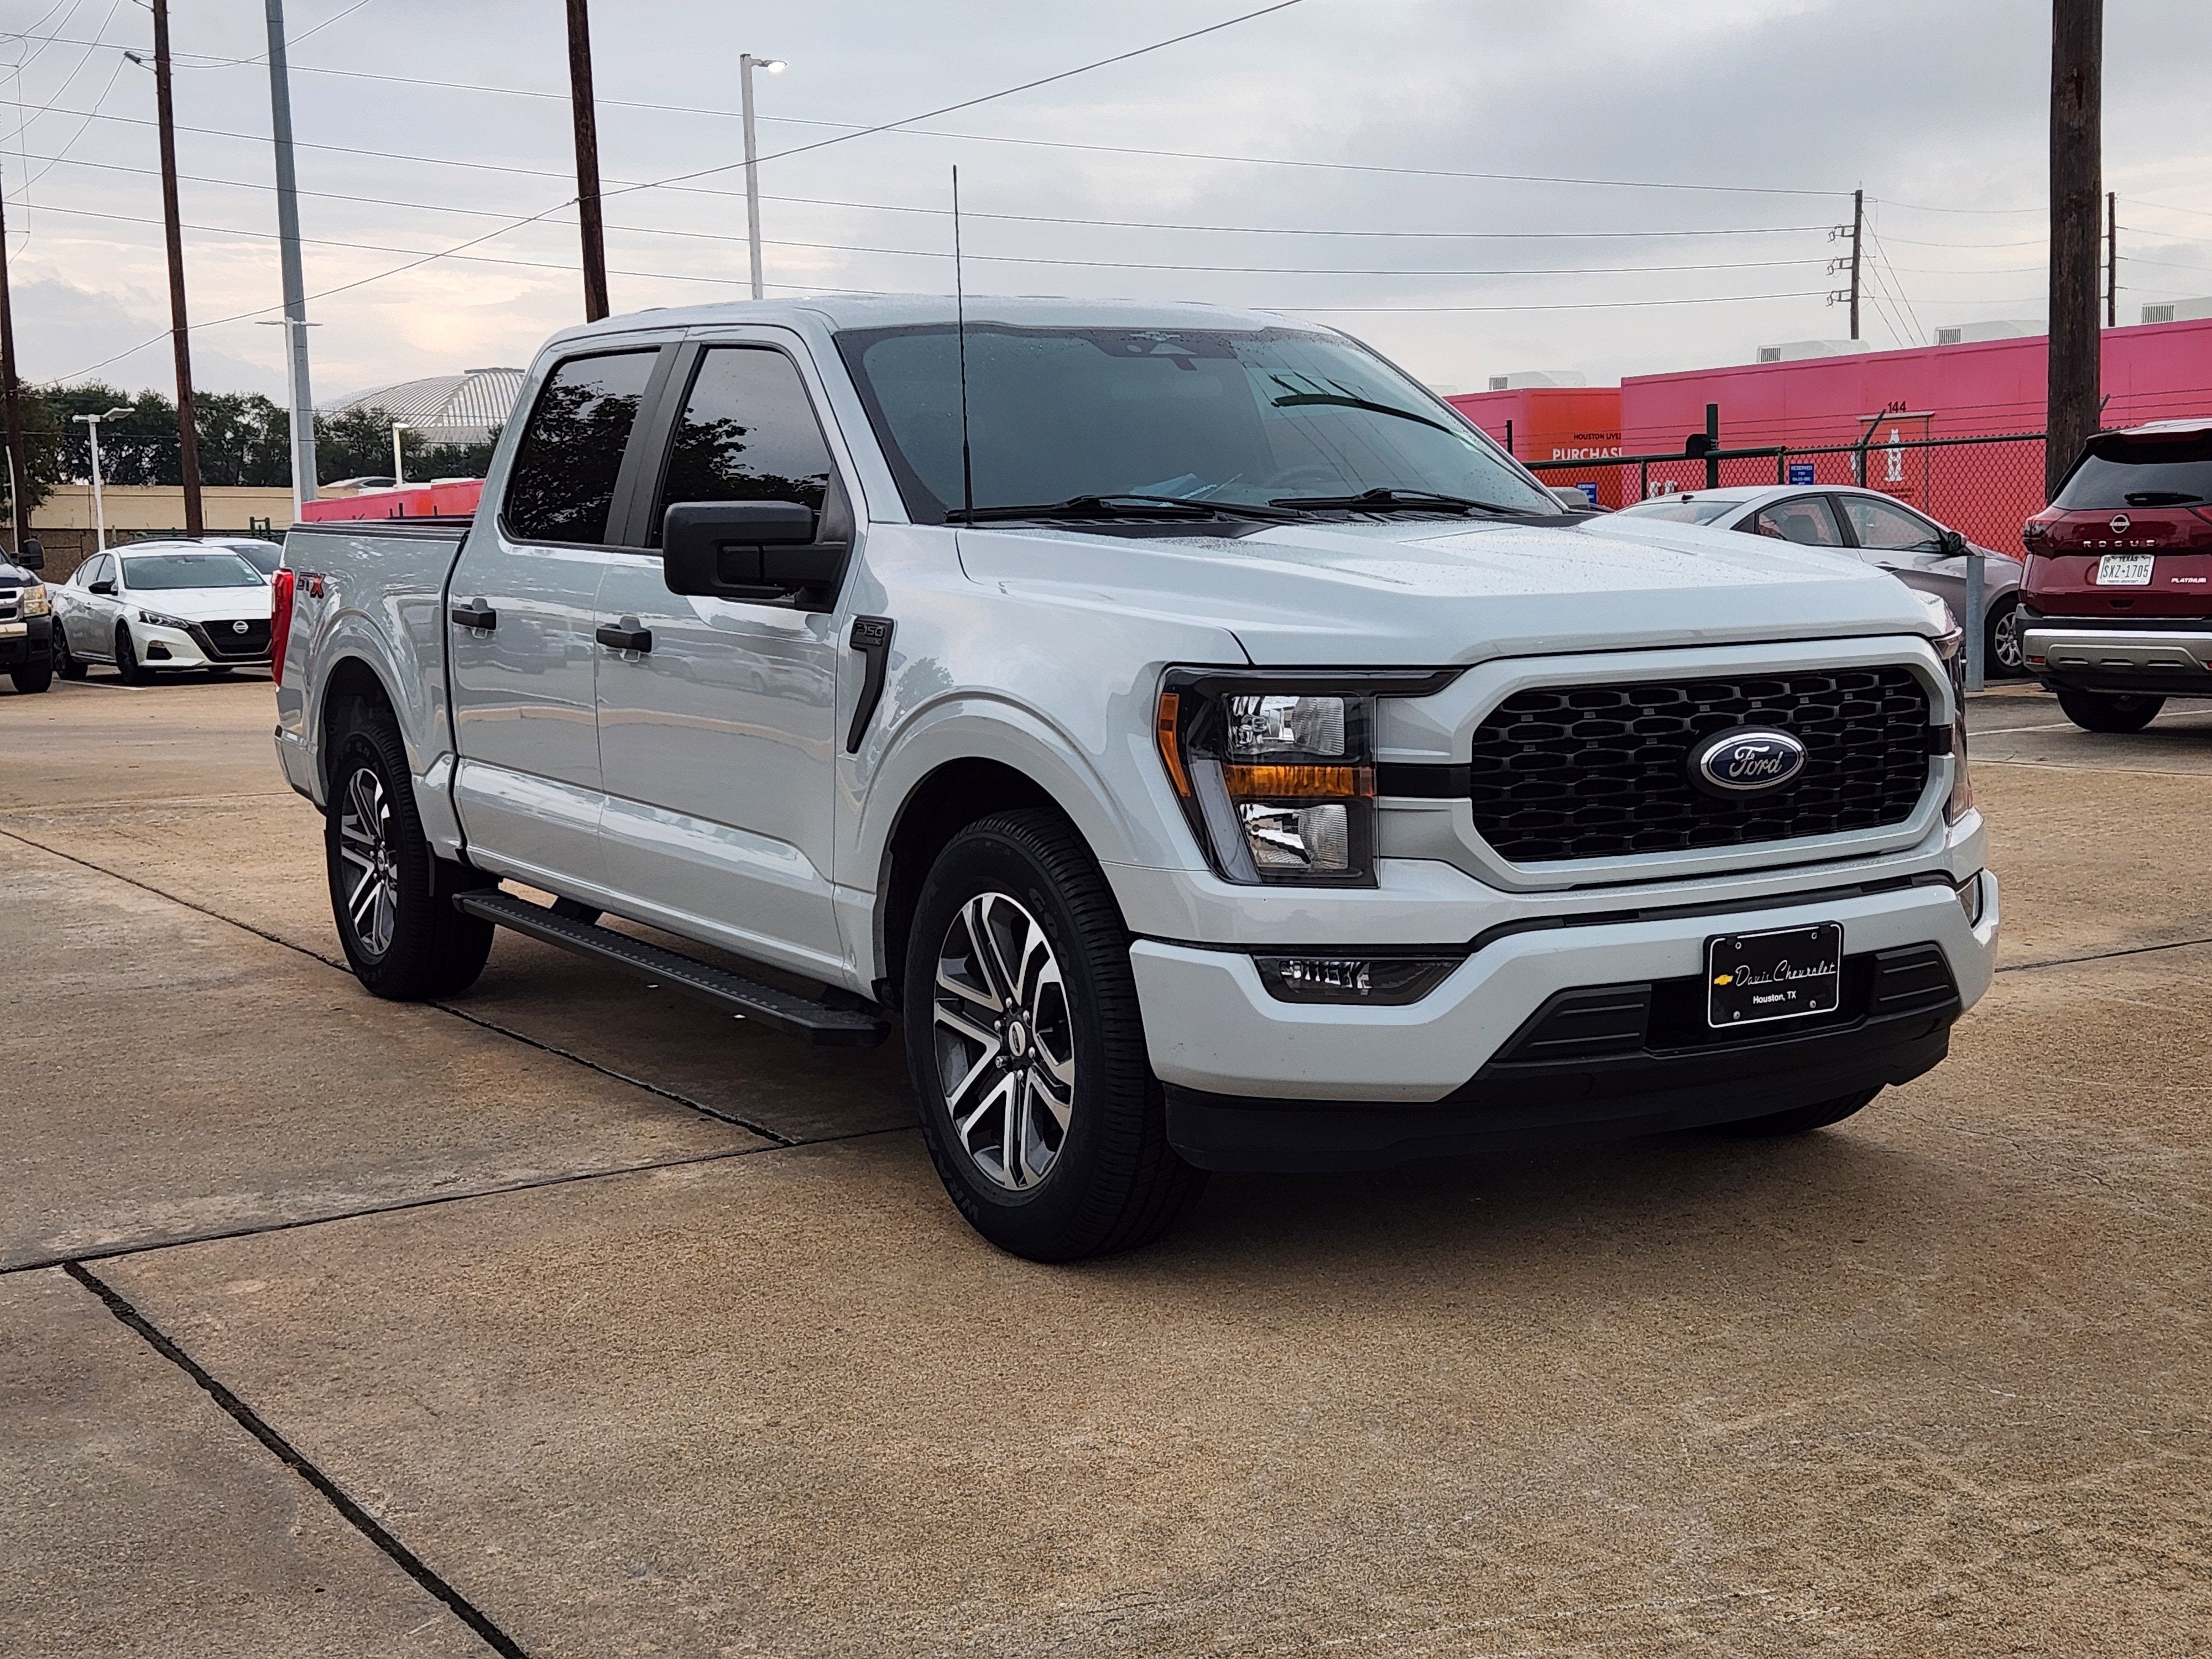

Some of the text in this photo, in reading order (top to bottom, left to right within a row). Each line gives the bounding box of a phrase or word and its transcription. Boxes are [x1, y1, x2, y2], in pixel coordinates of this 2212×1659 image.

[1887, 400, 1906, 413] 144
[2083, 540, 2155, 548] ROGUE
[1729, 745, 1783, 777] Ford
[1735, 959, 1837, 987] Davis Chevrolet
[1752, 990, 1797, 1004] Houston, TX
